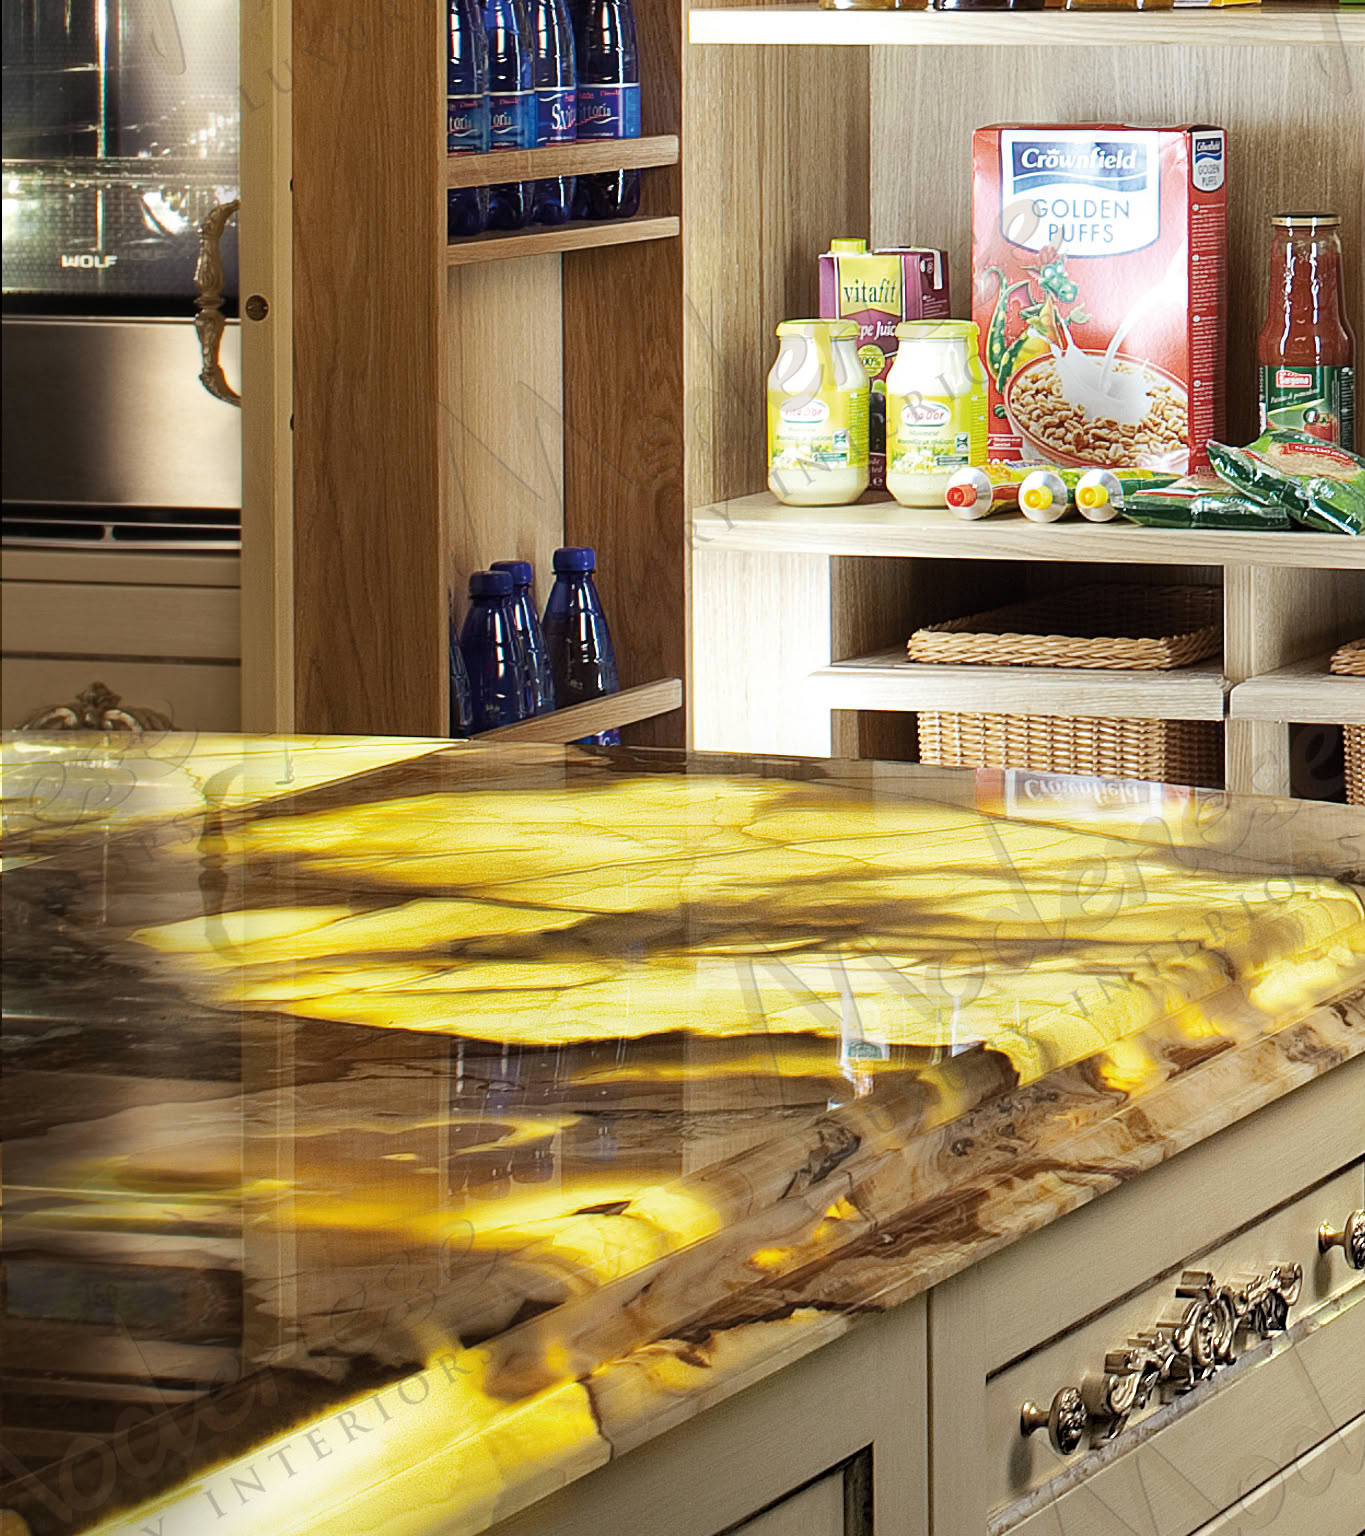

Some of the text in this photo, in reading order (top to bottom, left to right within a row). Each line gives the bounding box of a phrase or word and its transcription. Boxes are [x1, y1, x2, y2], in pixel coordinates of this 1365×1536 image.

[1021, 147, 1136, 169] Crownfield
[1032, 199, 1130, 219] GOLDEN
[1048, 224, 1114, 243] PUFFS
[843, 278, 896, 304] vitafit
